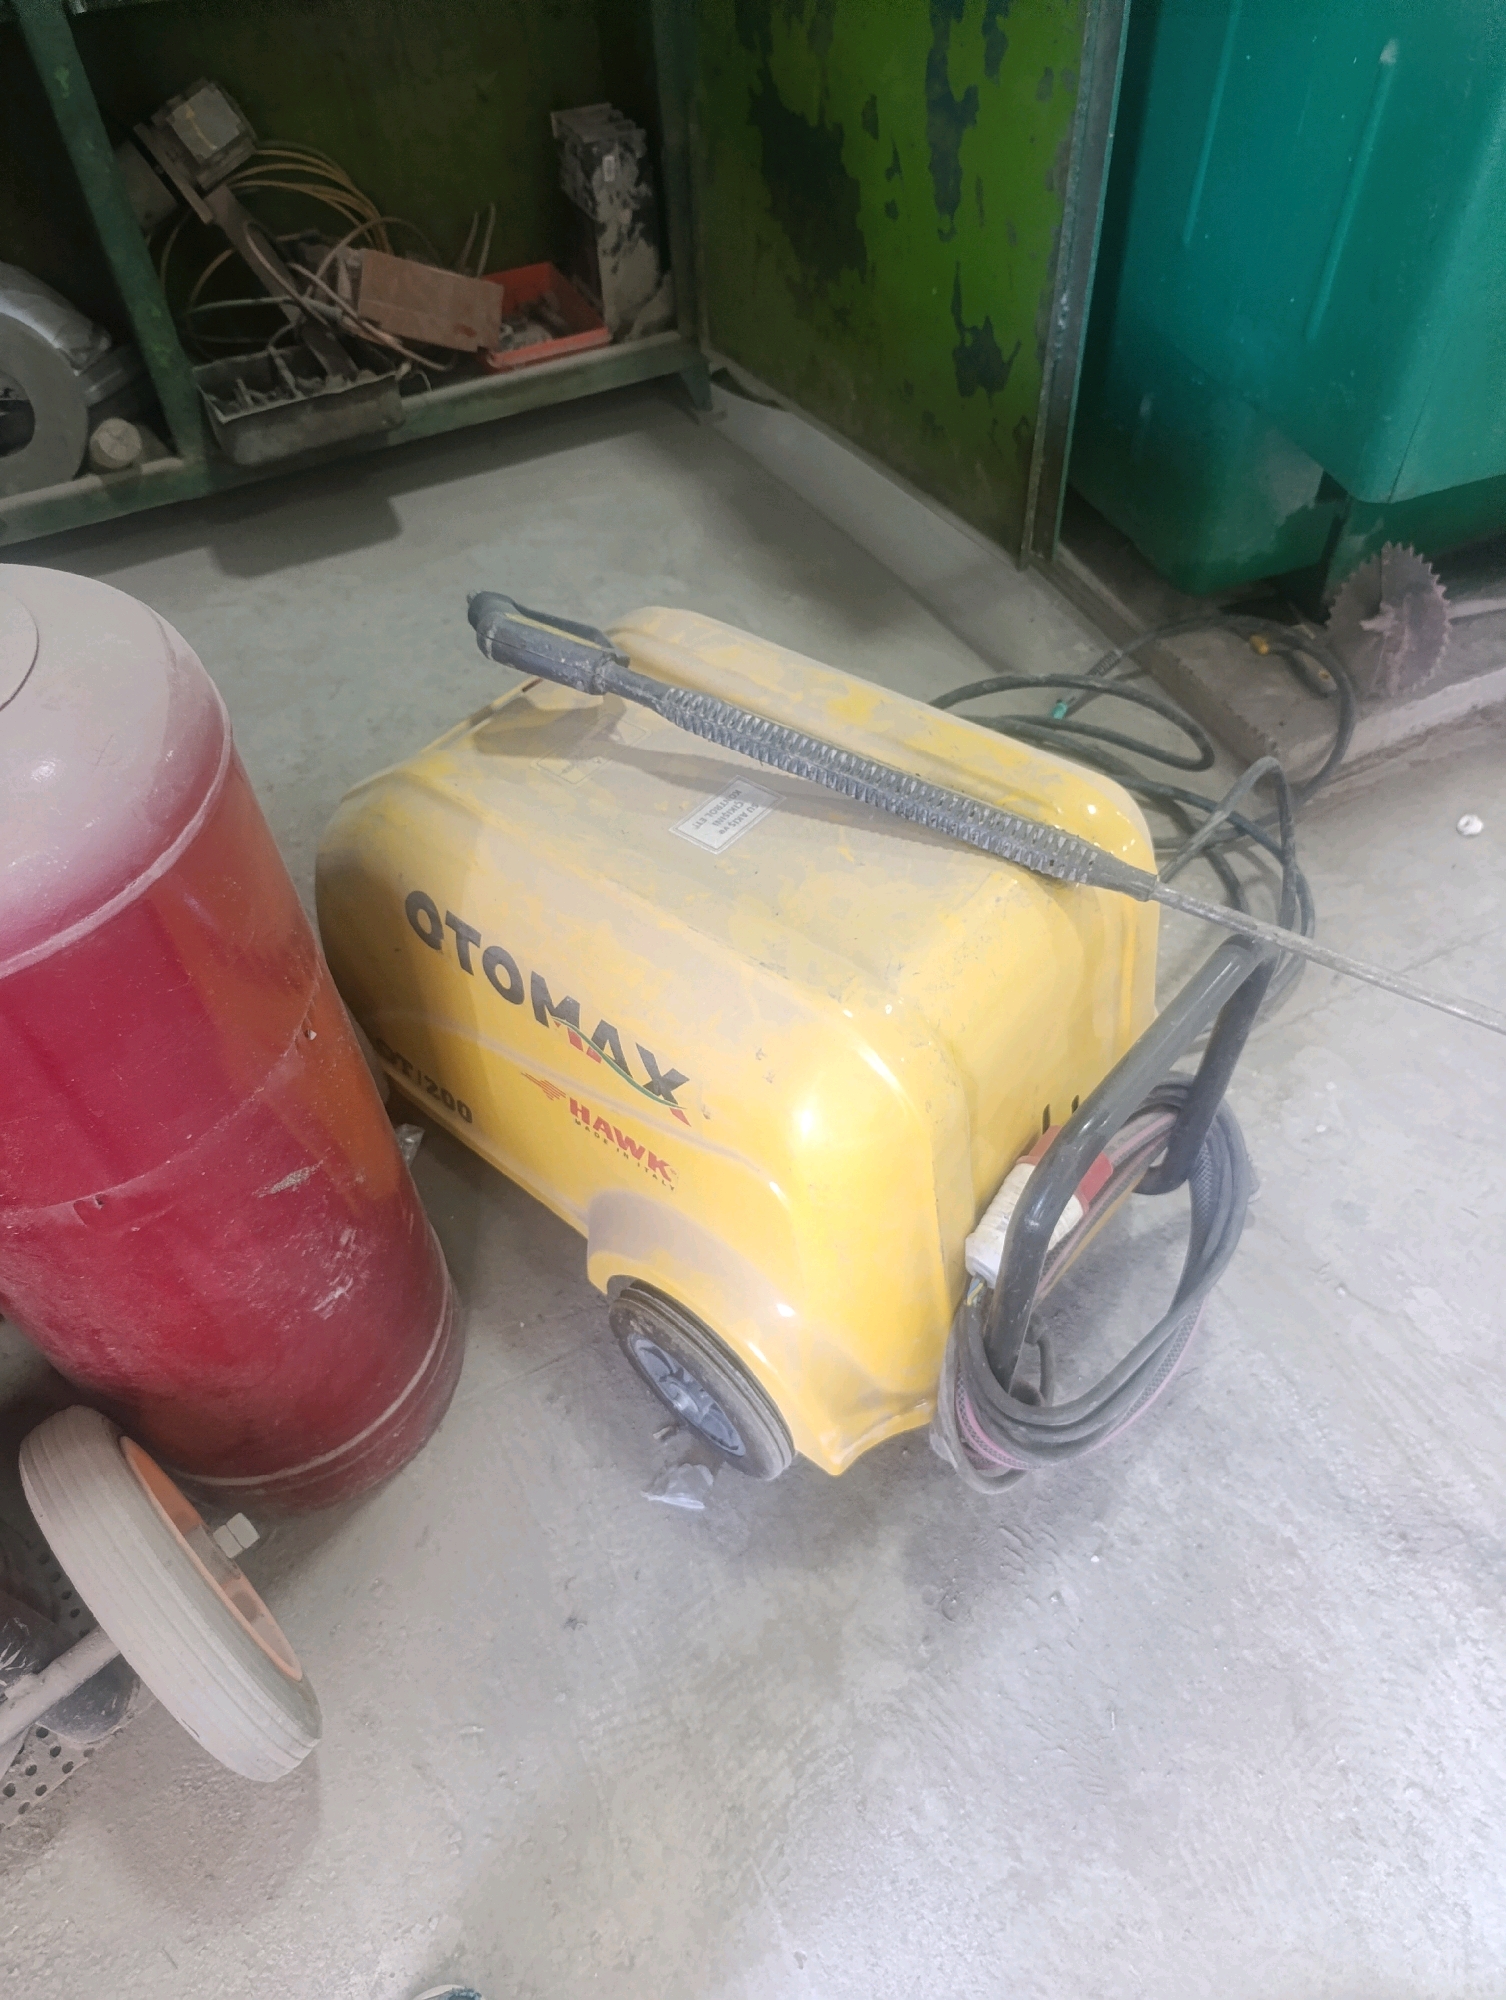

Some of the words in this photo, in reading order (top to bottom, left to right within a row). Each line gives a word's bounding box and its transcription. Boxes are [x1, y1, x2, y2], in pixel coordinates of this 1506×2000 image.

[705, 789, 742, 817] KONTROL
[404, 890, 692, 1127] OTOMAX
[571, 1097, 672, 1182] HAWK
[574, 1118, 608, 1145] MADE
[616, 1148, 629, 1159] IN
[637, 1162, 675, 1191] ITALY
